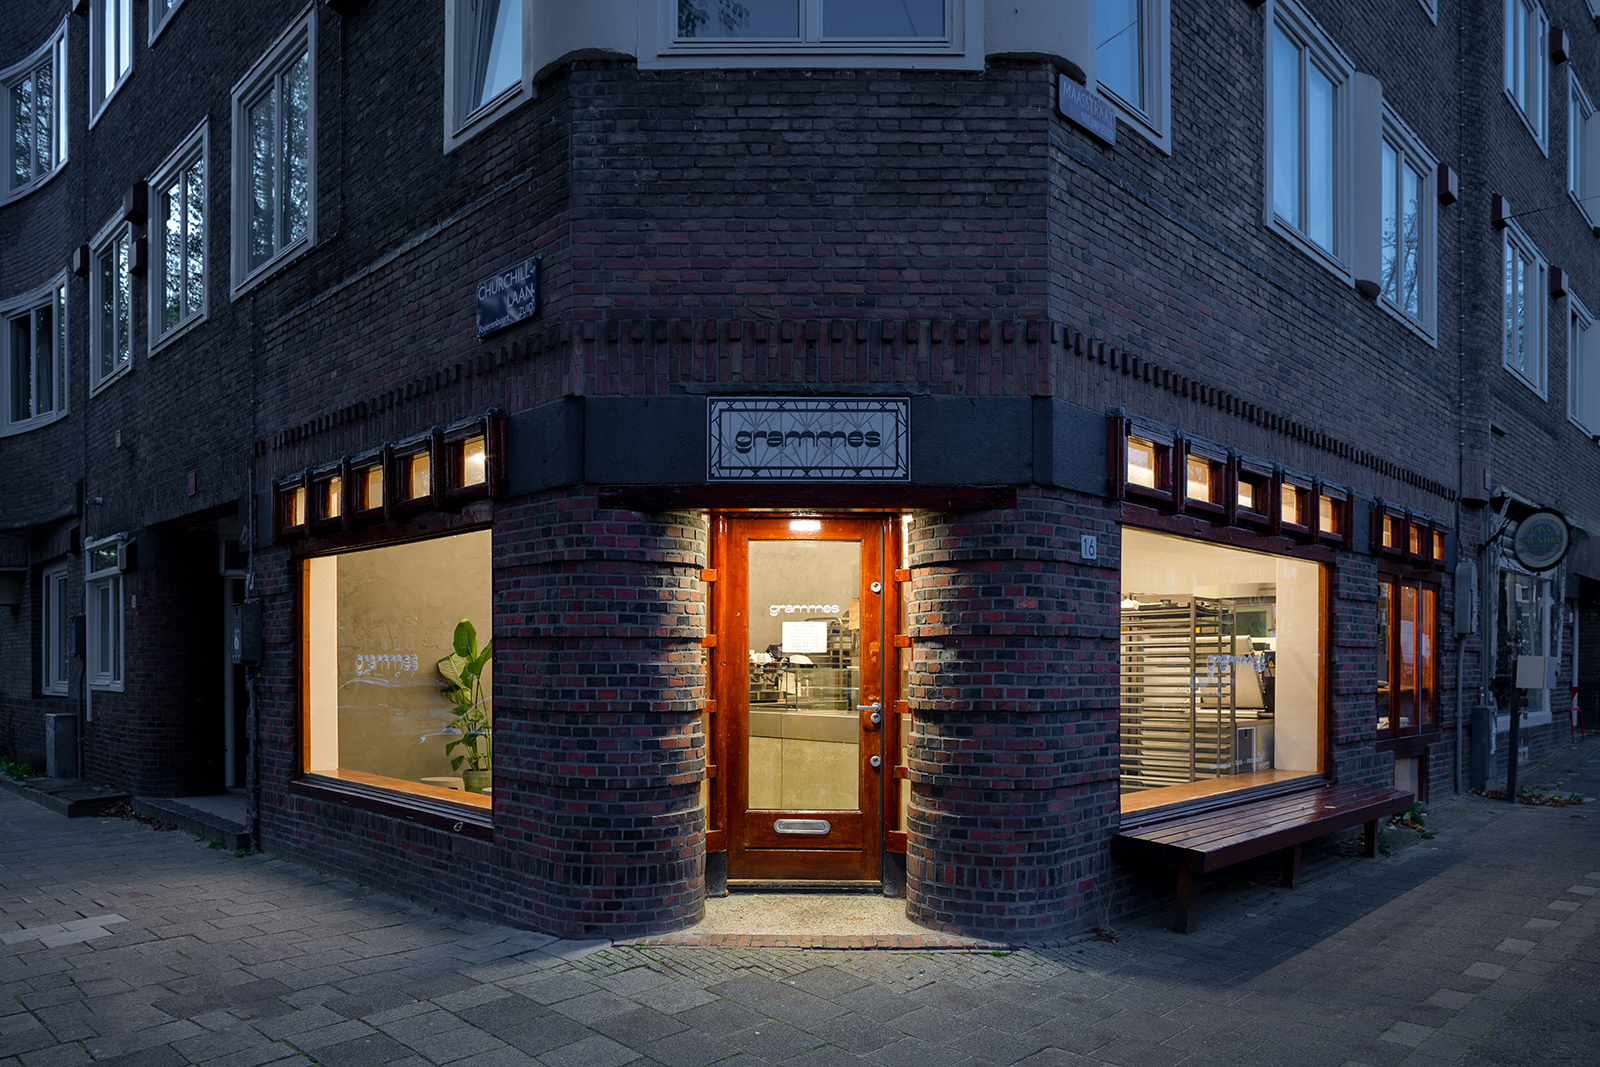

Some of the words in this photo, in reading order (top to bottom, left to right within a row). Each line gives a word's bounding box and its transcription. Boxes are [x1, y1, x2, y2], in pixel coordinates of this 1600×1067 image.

[1063, 80, 1116, 128] MAASSTRAAT
[506, 282, 535, 308] LAAN
[519, 302, 534, 316] ZUID
[735, 430, 881, 454] grammes
[1519, 535, 1563, 545] LAUNDRY
[1530, 526, 1552, 534] EASY
[1083, 538, 1095, 556] 16
[769, 604, 840, 617] grammes
[355, 654, 418, 676] grammes
[1207, 655, 1266, 678] grammes
